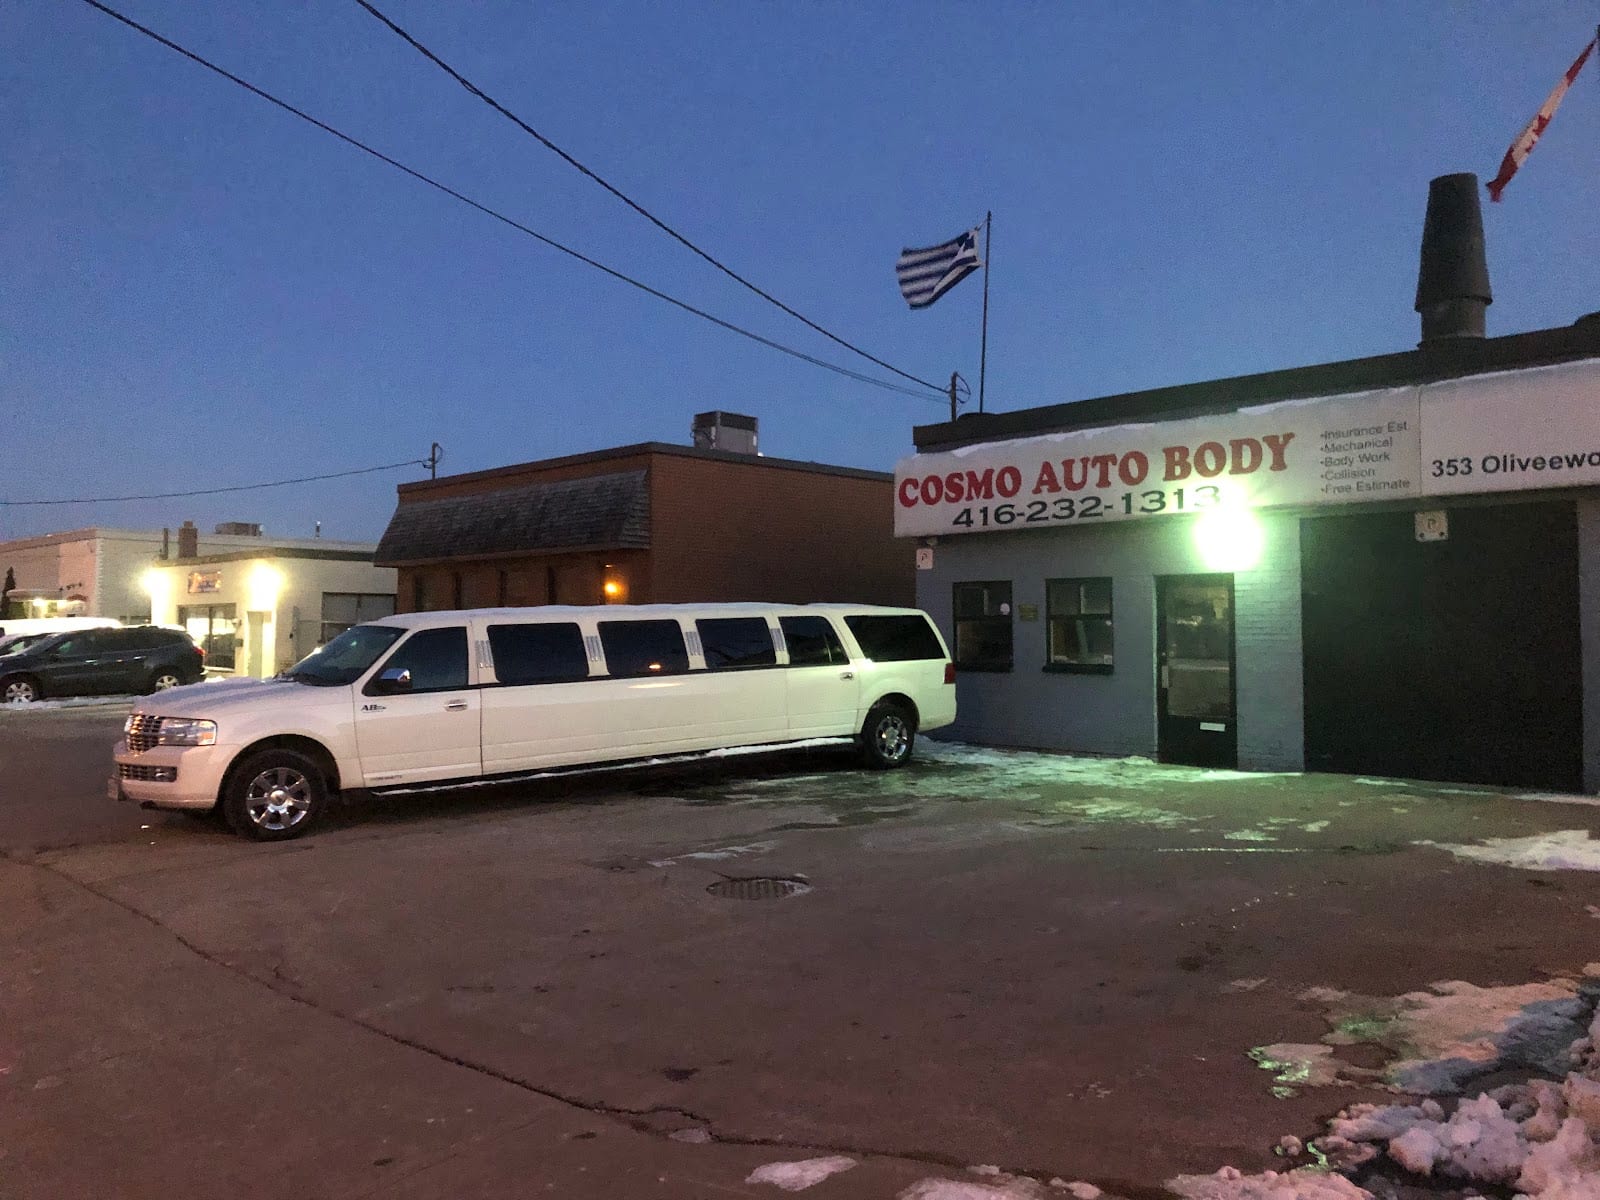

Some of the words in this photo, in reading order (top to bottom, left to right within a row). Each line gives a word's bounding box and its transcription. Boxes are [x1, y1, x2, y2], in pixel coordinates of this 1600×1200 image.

[1325, 436, 1393, 453] Mechanical
[1325, 456, 1354, 467] Body
[1358, 452, 1390, 463] Work
[1432, 457, 1472, 477] 353
[899, 465, 1022, 508] COSMO
[1031, 451, 1149, 495] AUTO
[1163, 432, 1296, 481] BODY
[952, 485, 1221, 528] 416-232-1313
